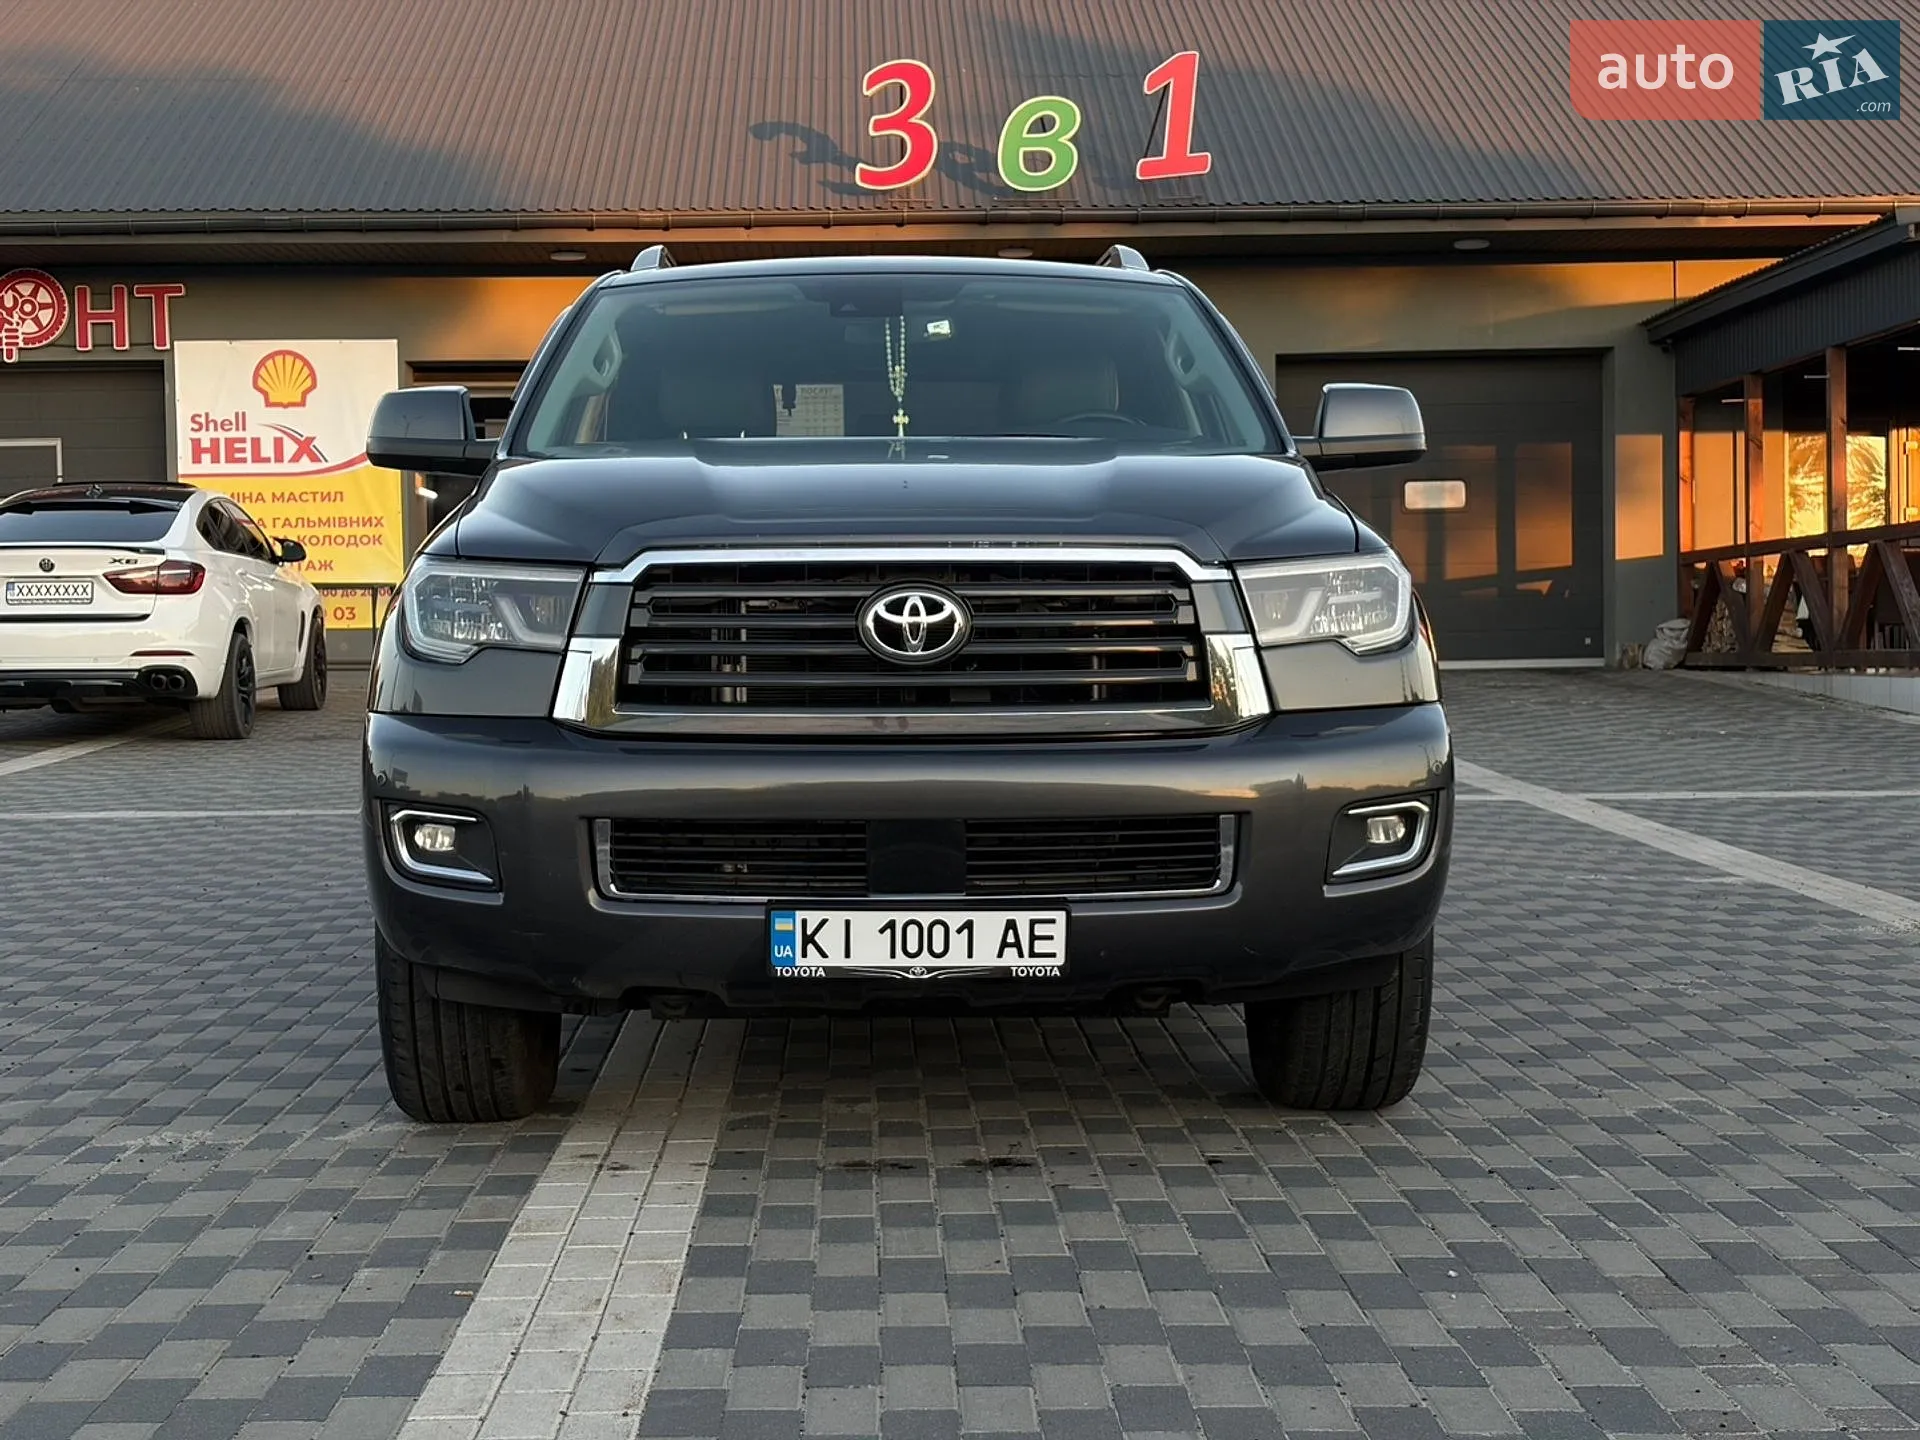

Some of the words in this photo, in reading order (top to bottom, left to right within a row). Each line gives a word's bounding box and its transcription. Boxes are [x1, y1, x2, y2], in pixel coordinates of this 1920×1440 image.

[855, 59, 938, 191] 3
[1135, 50, 1212, 181] 1
[190, 411, 246, 432] Shell
[190, 436, 323, 464] HELIX
[271, 491, 344, 504] МАСТИЛ
[272, 516, 385, 528] ГАЛЬМІВНИХ
[297, 534, 383, 547] КОЛОДОК
[801, 918, 852, 958] KI
[878, 918, 974, 959] 1001
[996, 918, 1057, 958] AE
[774, 945, 793, 957] UA
[775, 966, 826, 977] TOYOTA
[1010, 966, 1060, 977] TOYOTA
